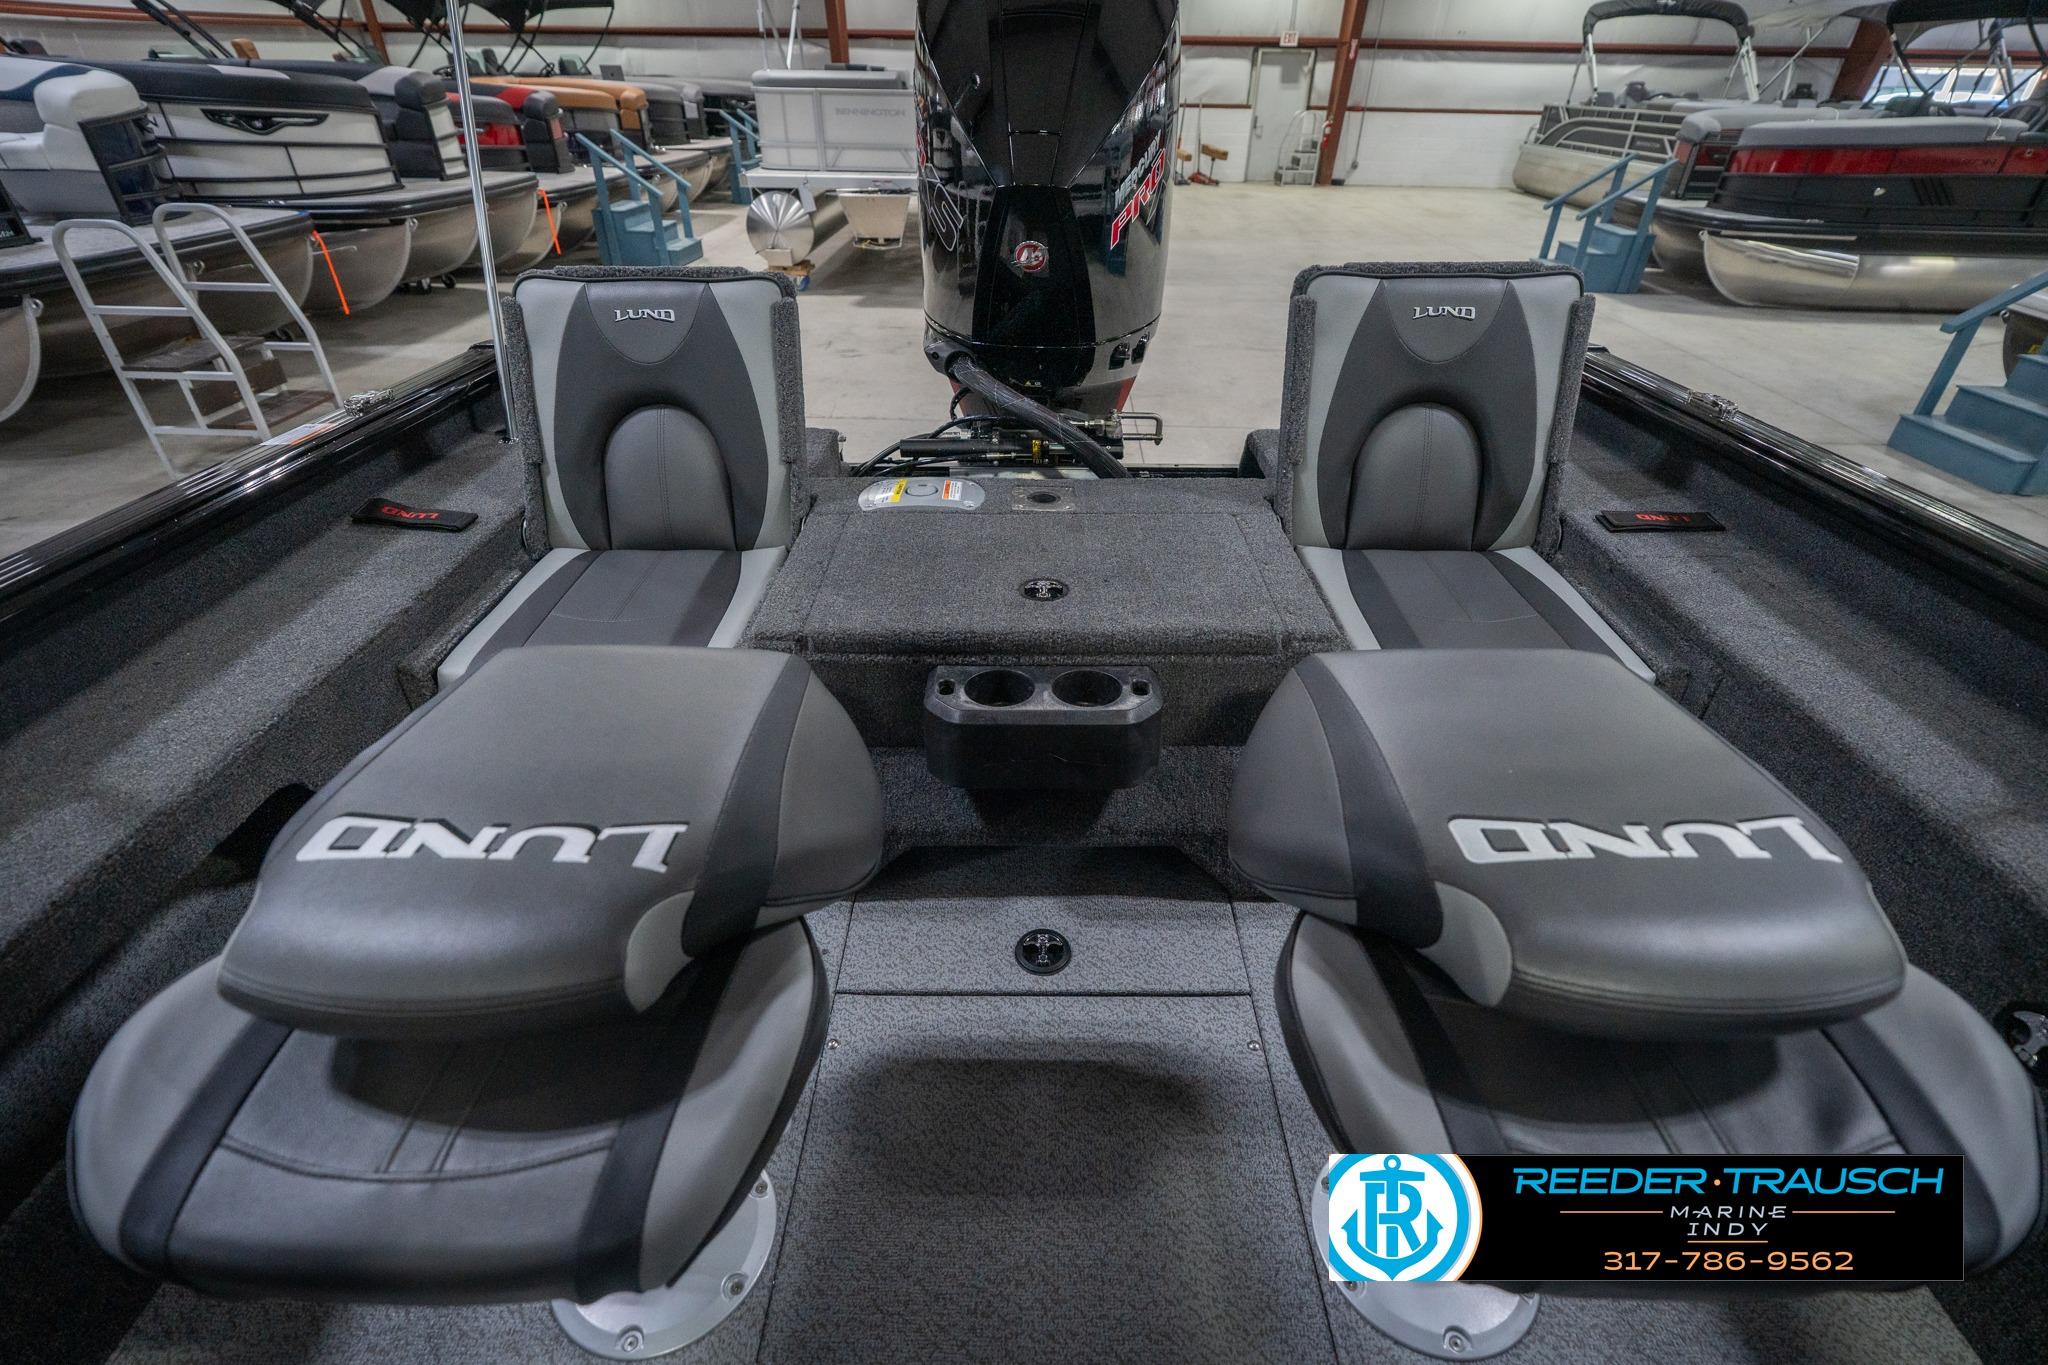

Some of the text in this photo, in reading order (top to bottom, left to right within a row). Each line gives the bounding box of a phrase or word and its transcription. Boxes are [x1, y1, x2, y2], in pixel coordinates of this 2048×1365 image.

[1114, 129, 1161, 209] MERCURY
[1110, 147, 1166, 251] PRO
[614, 308, 675, 322] LUND
[1413, 306, 1476, 320] LUND
[382, 505, 439, 520] LUND
[296, 812, 690, 874] LUND
[1446, 814, 1843, 864] LUND
